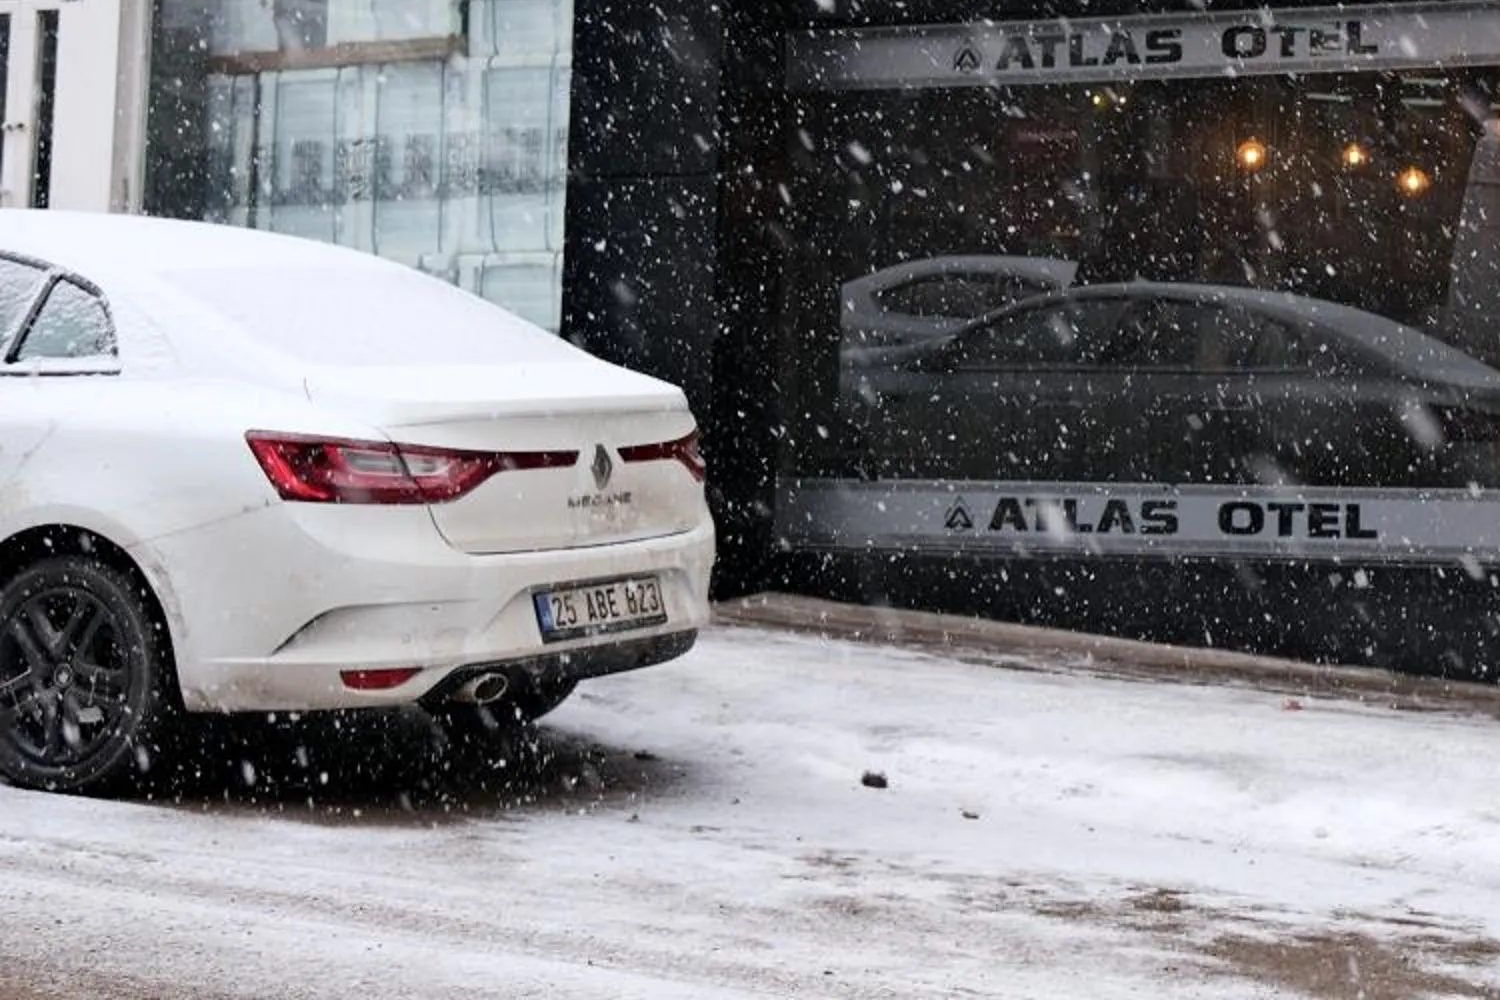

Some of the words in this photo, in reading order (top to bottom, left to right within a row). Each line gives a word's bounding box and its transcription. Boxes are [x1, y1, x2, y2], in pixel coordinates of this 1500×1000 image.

[996, 26, 1183, 70] ATLAS
[1221, 19, 1378, 59] OTEL
[988, 496, 1179, 536] ATLAS
[1218, 500, 1378, 540] OTEL
[552, 592, 577, 627] 25
[587, 588, 620, 621] ABE
